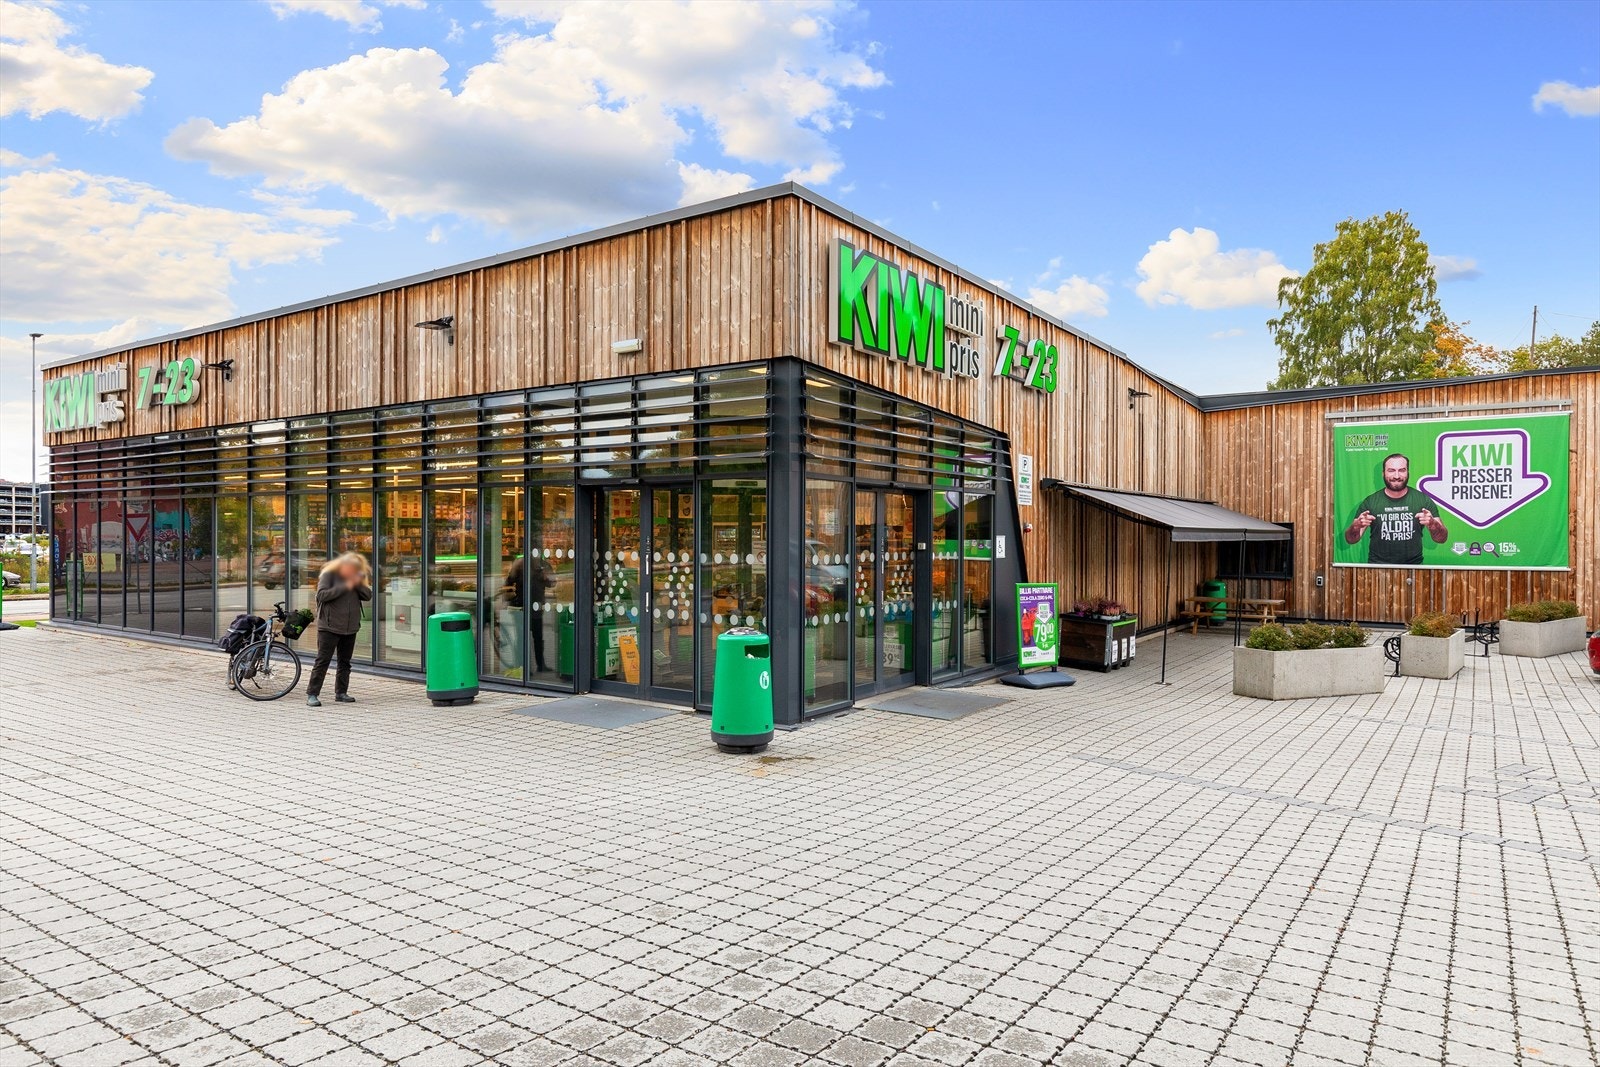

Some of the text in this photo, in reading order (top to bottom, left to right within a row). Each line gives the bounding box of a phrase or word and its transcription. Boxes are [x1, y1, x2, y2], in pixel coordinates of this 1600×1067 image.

[832, 238, 945, 374] KIWI
[949, 293, 984, 337] mini
[949, 337, 980, 378] pris
[998, 324, 1058, 394] 7-23
[97, 366, 121, 393] mini
[136, 357, 197, 411] 7-23
[45, 372, 95, 432] KIWI
[97, 400, 118, 426] pris
[1345, 434, 1374, 447] KIWI
[1452, 443, 1513, 468] KIWI
[1452, 468, 1513, 484] PRESSER
[1452, 484, 1513, 500] PRISENE!
[1381, 520, 1414, 533] ALDRI
